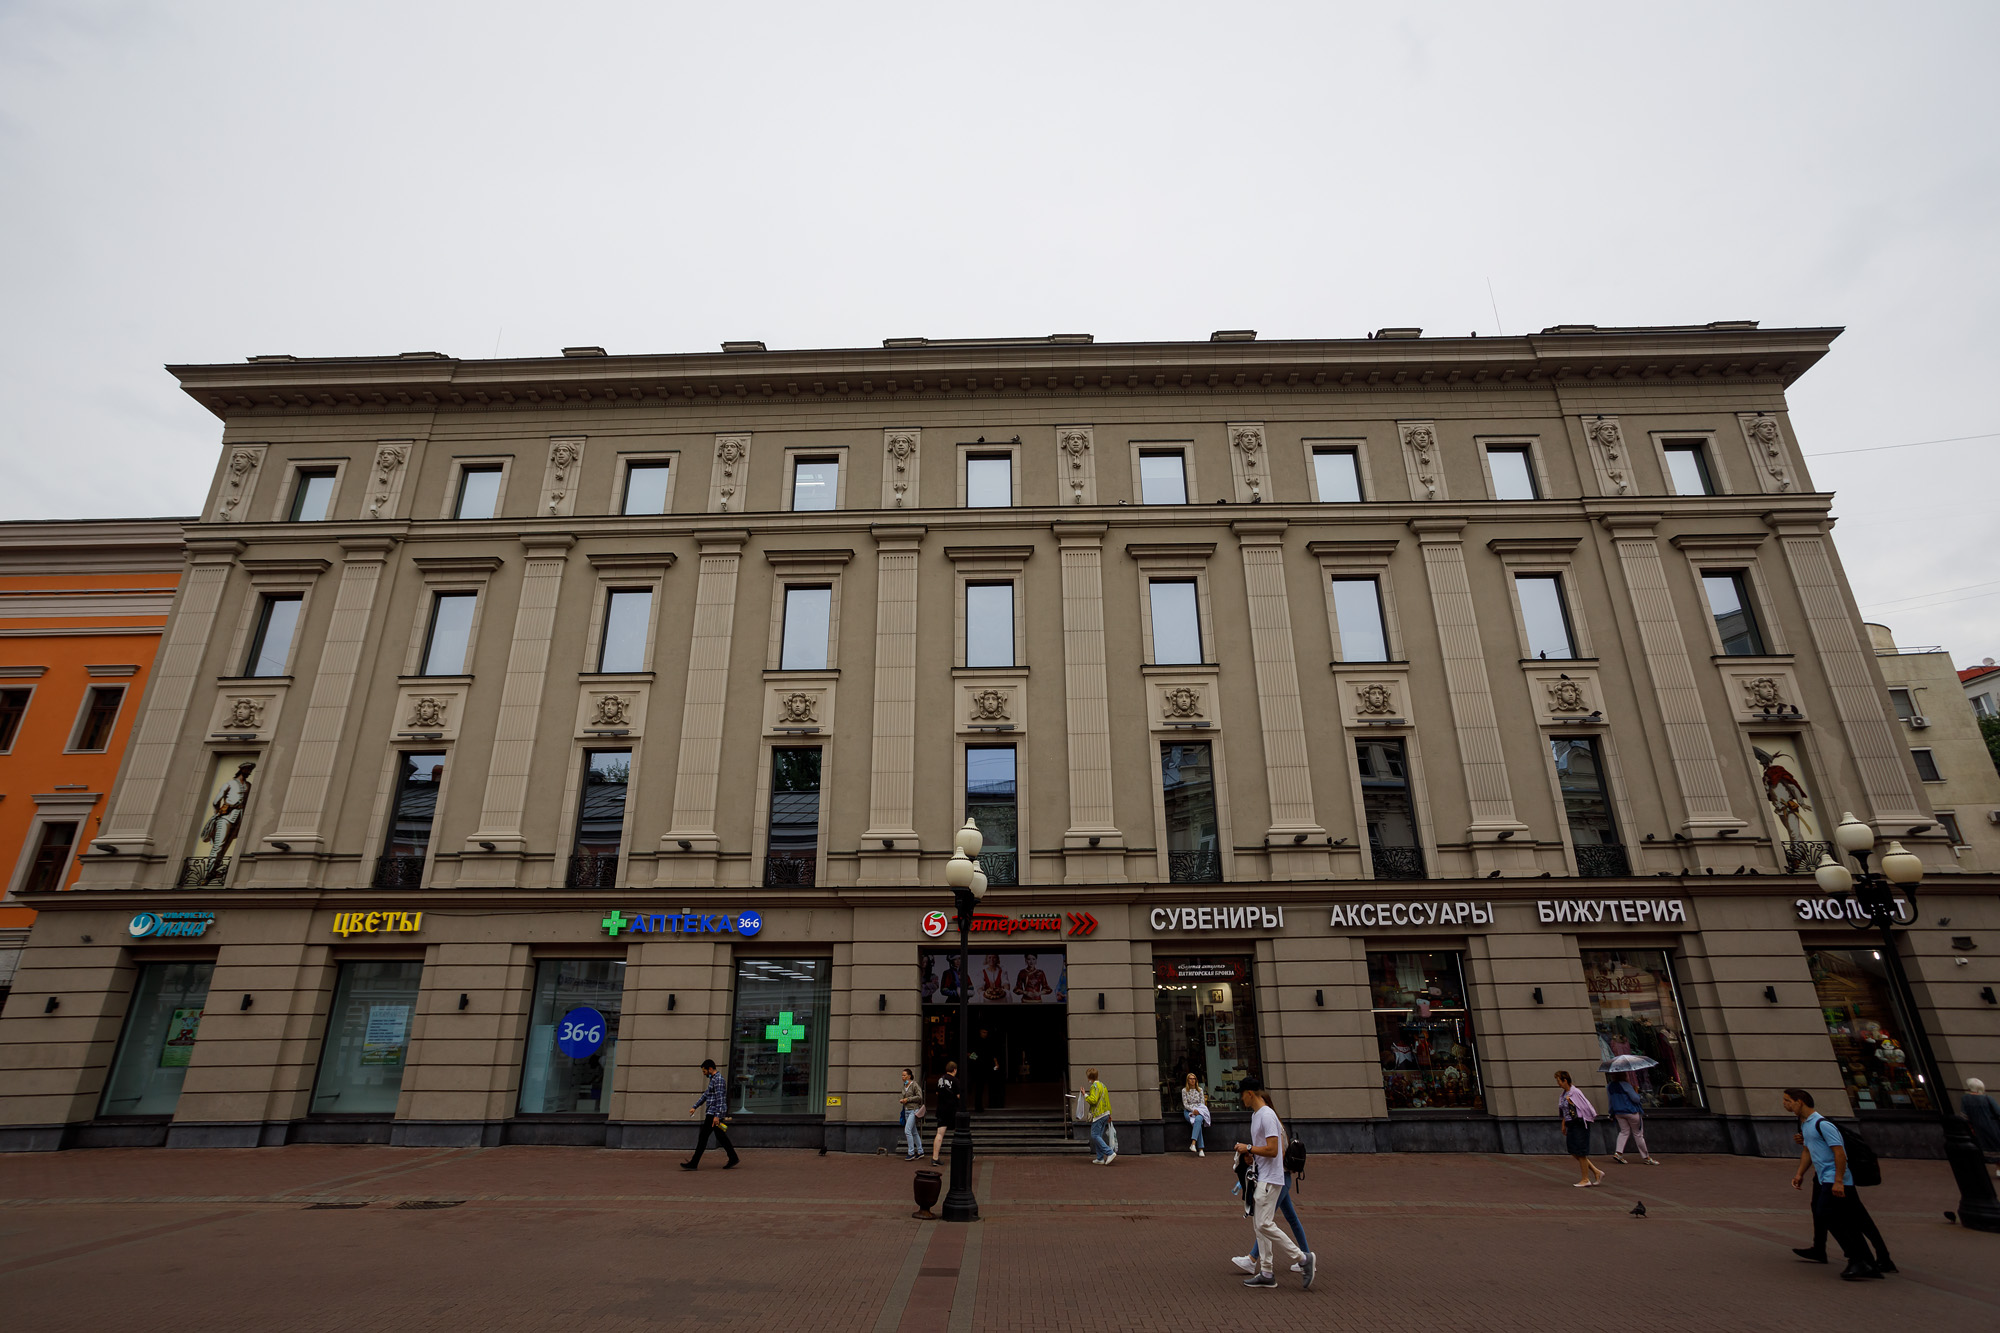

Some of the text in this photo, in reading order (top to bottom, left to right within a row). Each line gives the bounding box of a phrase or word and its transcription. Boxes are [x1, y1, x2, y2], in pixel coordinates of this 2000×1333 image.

[629, 914, 733, 933] АПТЕКА
[1150, 906, 1284, 931] СУВЕНИРЫ
[1330, 901, 1494, 927] АКСЕССУАРЫ
[1537, 899, 1687, 923] БИЖУТЕРИЯ
[332, 911, 422, 938] ЦВЕТЫ
